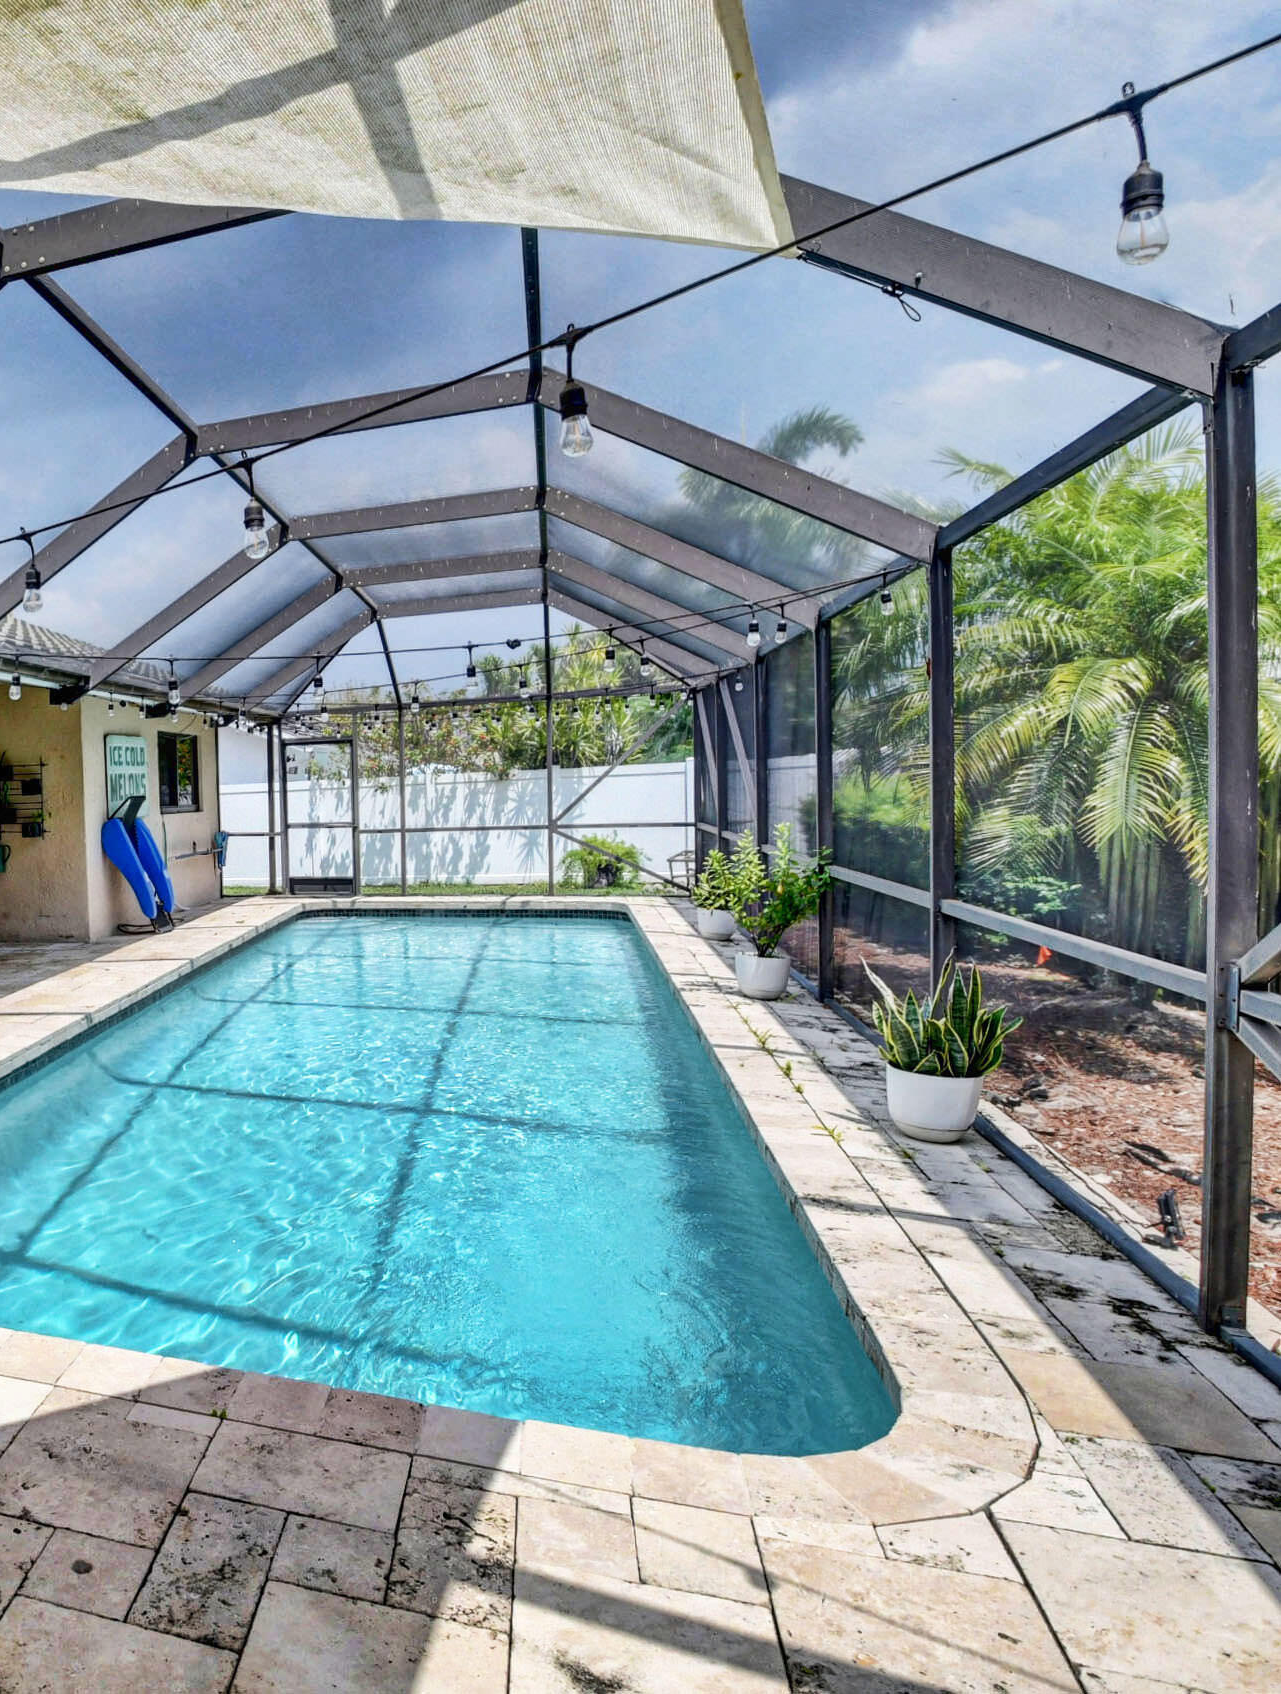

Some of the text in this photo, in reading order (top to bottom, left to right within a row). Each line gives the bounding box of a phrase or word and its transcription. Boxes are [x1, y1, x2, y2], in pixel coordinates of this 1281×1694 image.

[109, 746, 145, 767] ICE COLD
[110, 773, 146, 802] MELONS
